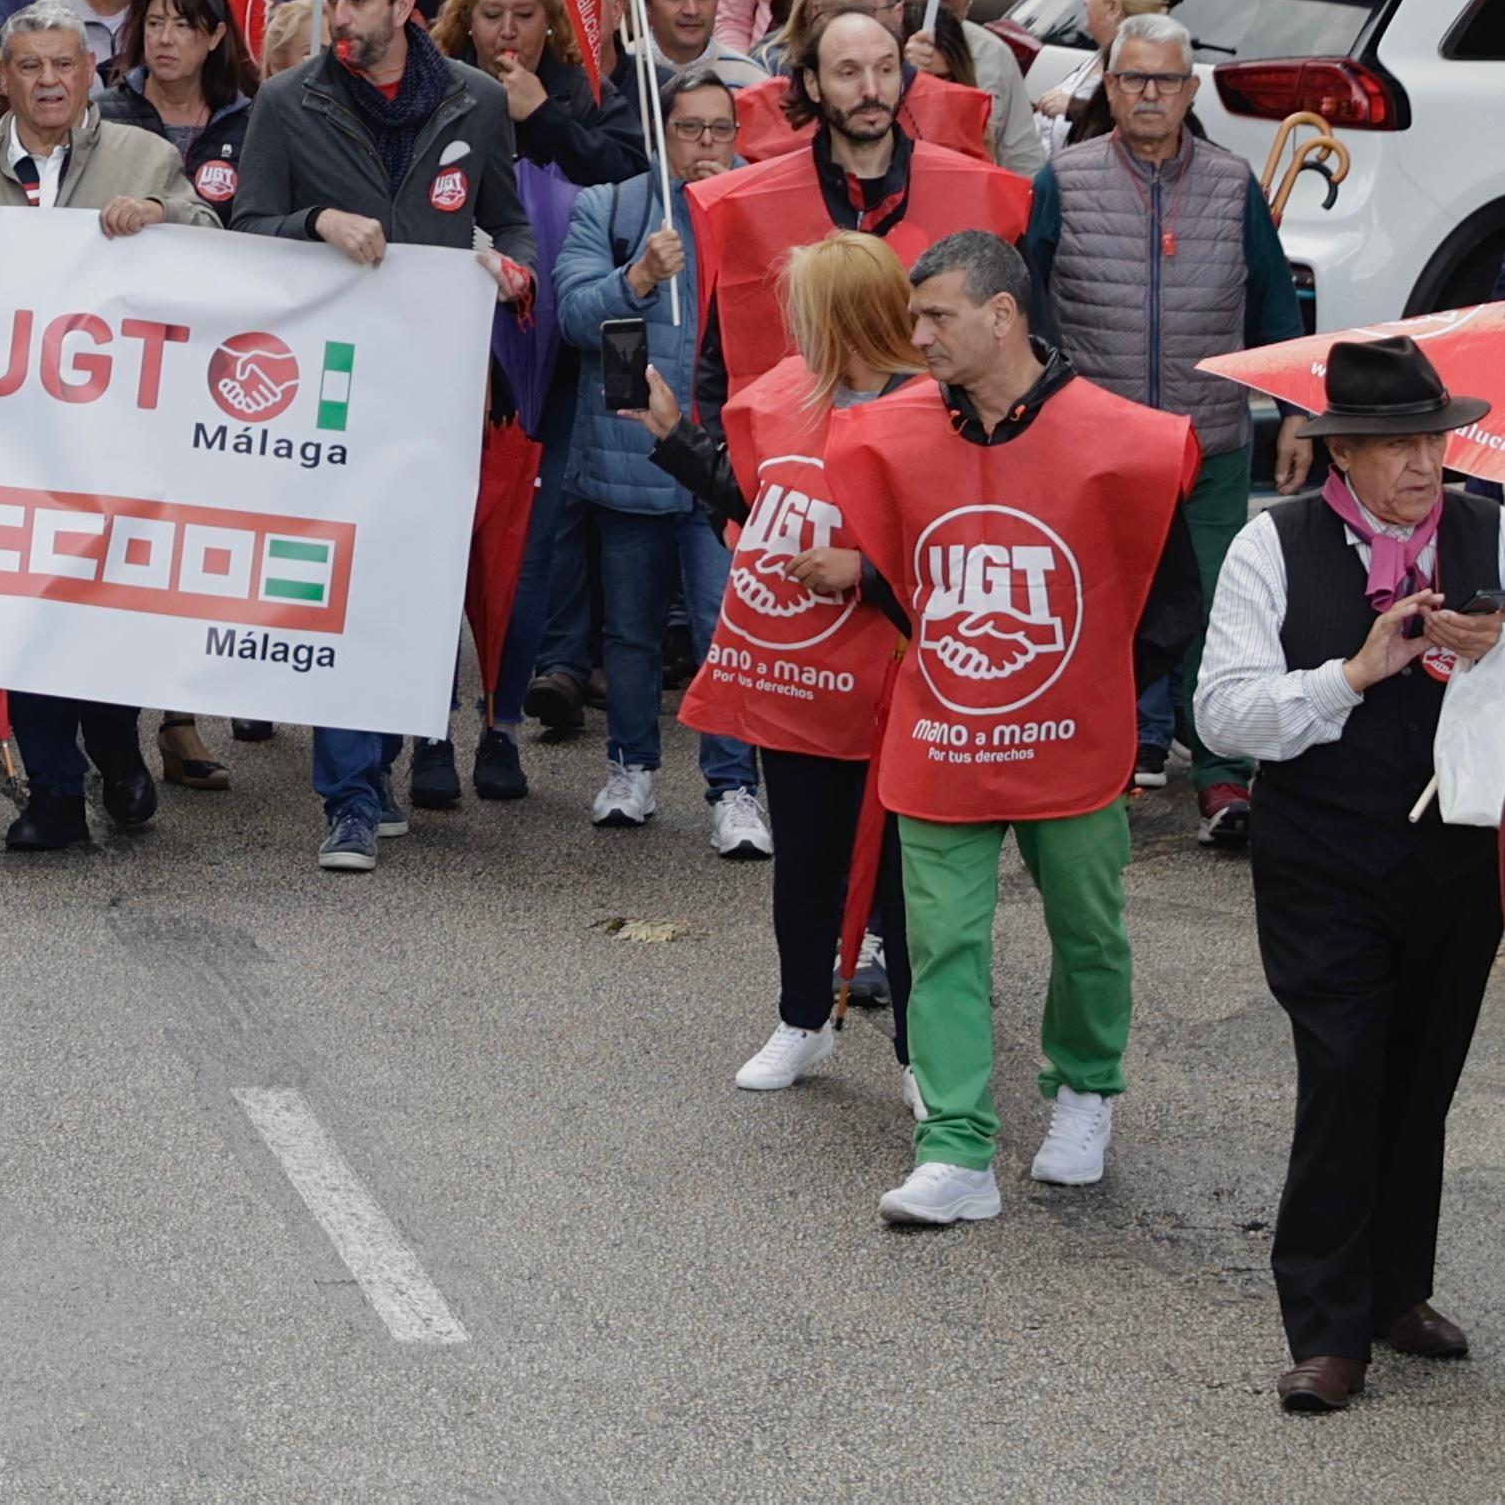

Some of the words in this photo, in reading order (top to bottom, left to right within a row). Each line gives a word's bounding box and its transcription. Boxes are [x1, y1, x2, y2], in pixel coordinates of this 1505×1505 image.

[191, 422, 349, 469] Málaga
[925, 543, 1056, 619] UGT
[204, 626, 337, 674] Málaga
[707, 644, 752, 670] ano
[756, 662, 767, 675] a
[774, 659, 854, 694] mano
[712, 668, 736, 683] Por
[756, 679, 815, 701] derechos
[911, 718, 969, 747] mano
[975, 731, 986, 745] a
[992, 718, 1076, 746] mano
[928, 746, 947, 761] Por
[948, 749, 972, 763] tus
[975, 747, 1035, 763] derechos
